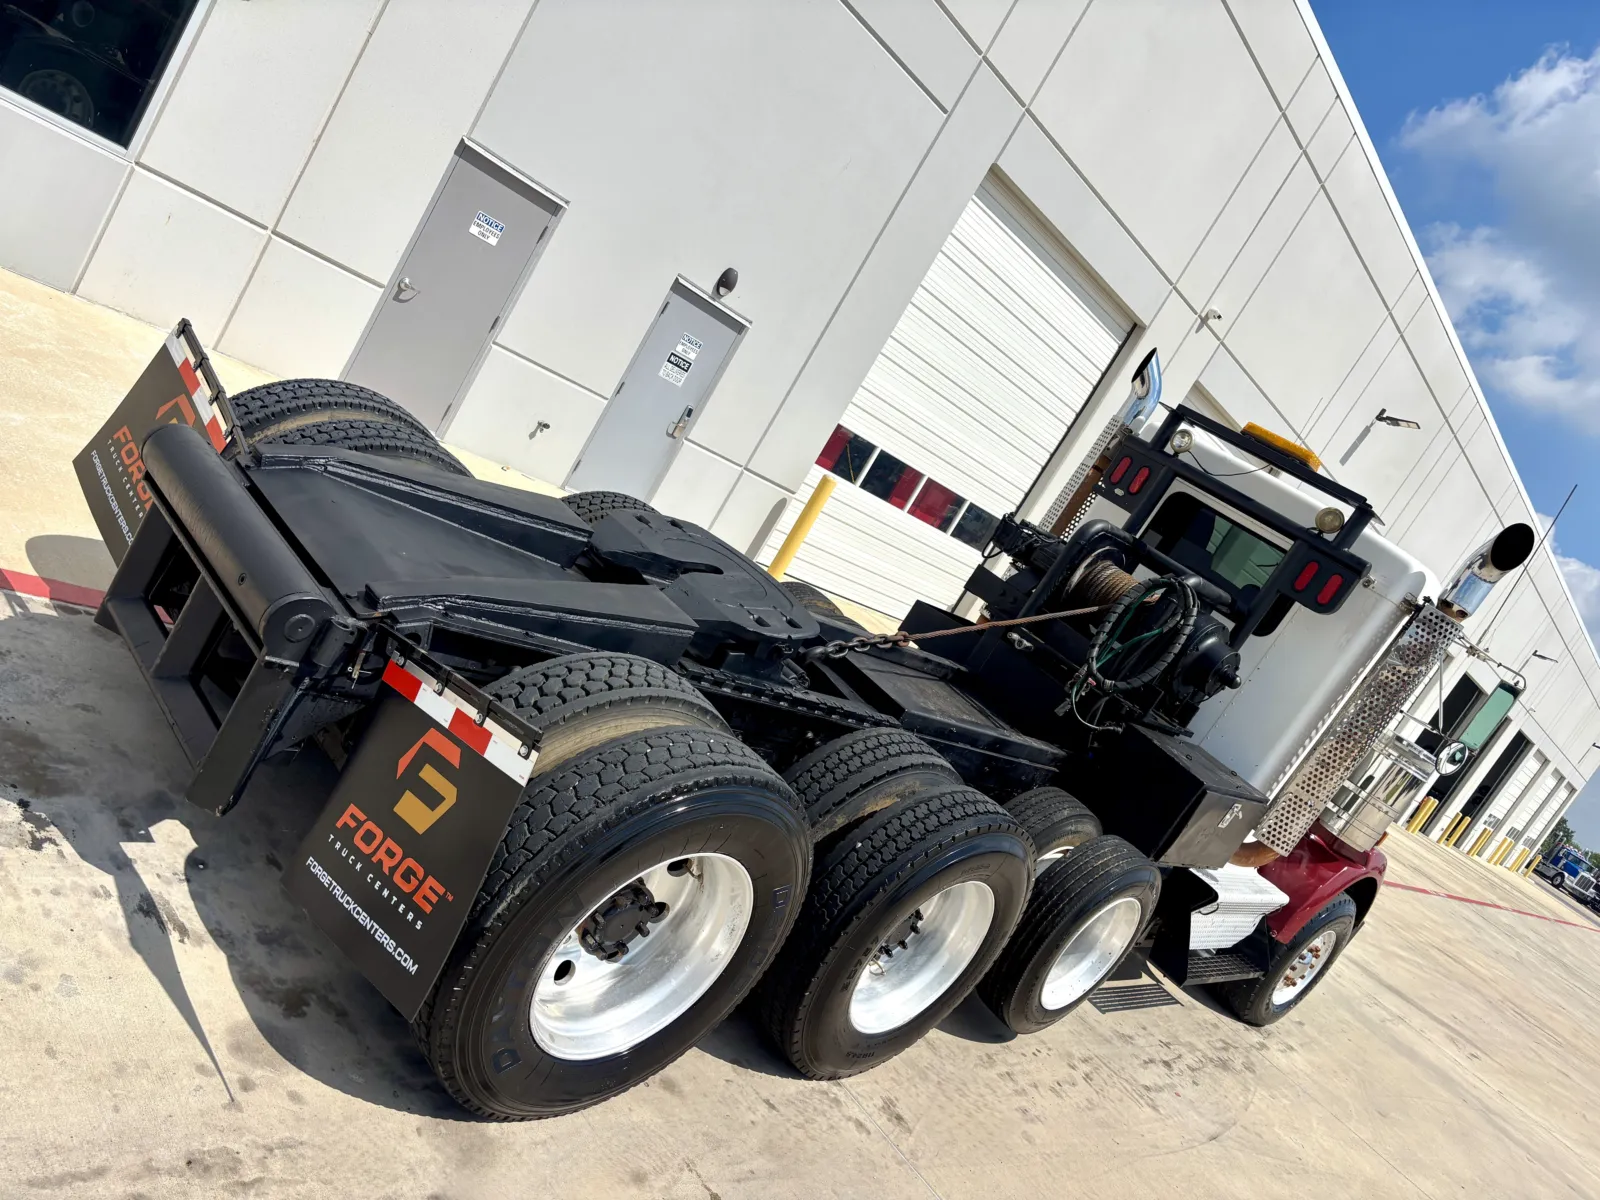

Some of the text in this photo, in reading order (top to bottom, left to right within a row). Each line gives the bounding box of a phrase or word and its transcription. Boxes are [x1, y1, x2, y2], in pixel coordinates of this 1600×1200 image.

[473, 220, 500, 239] EMPLOYEES
[478, 213, 503, 232] NOTICE
[478, 230, 490, 240] ONLY
[669, 354, 690, 370] NOTICE
[682, 334, 702, 349] NOTICE
[90, 449, 135, 546] FORGETRUCKCENTERS.CO
[106, 439, 144, 519] TRUCK CENTER
[113, 425, 154, 511] FORG
[328, 833, 423, 930] TRUCK CENTERS
[335, 803, 446, 914] FORGE
[305, 856, 419, 976] FORGETRUCKCENTERS.COM
